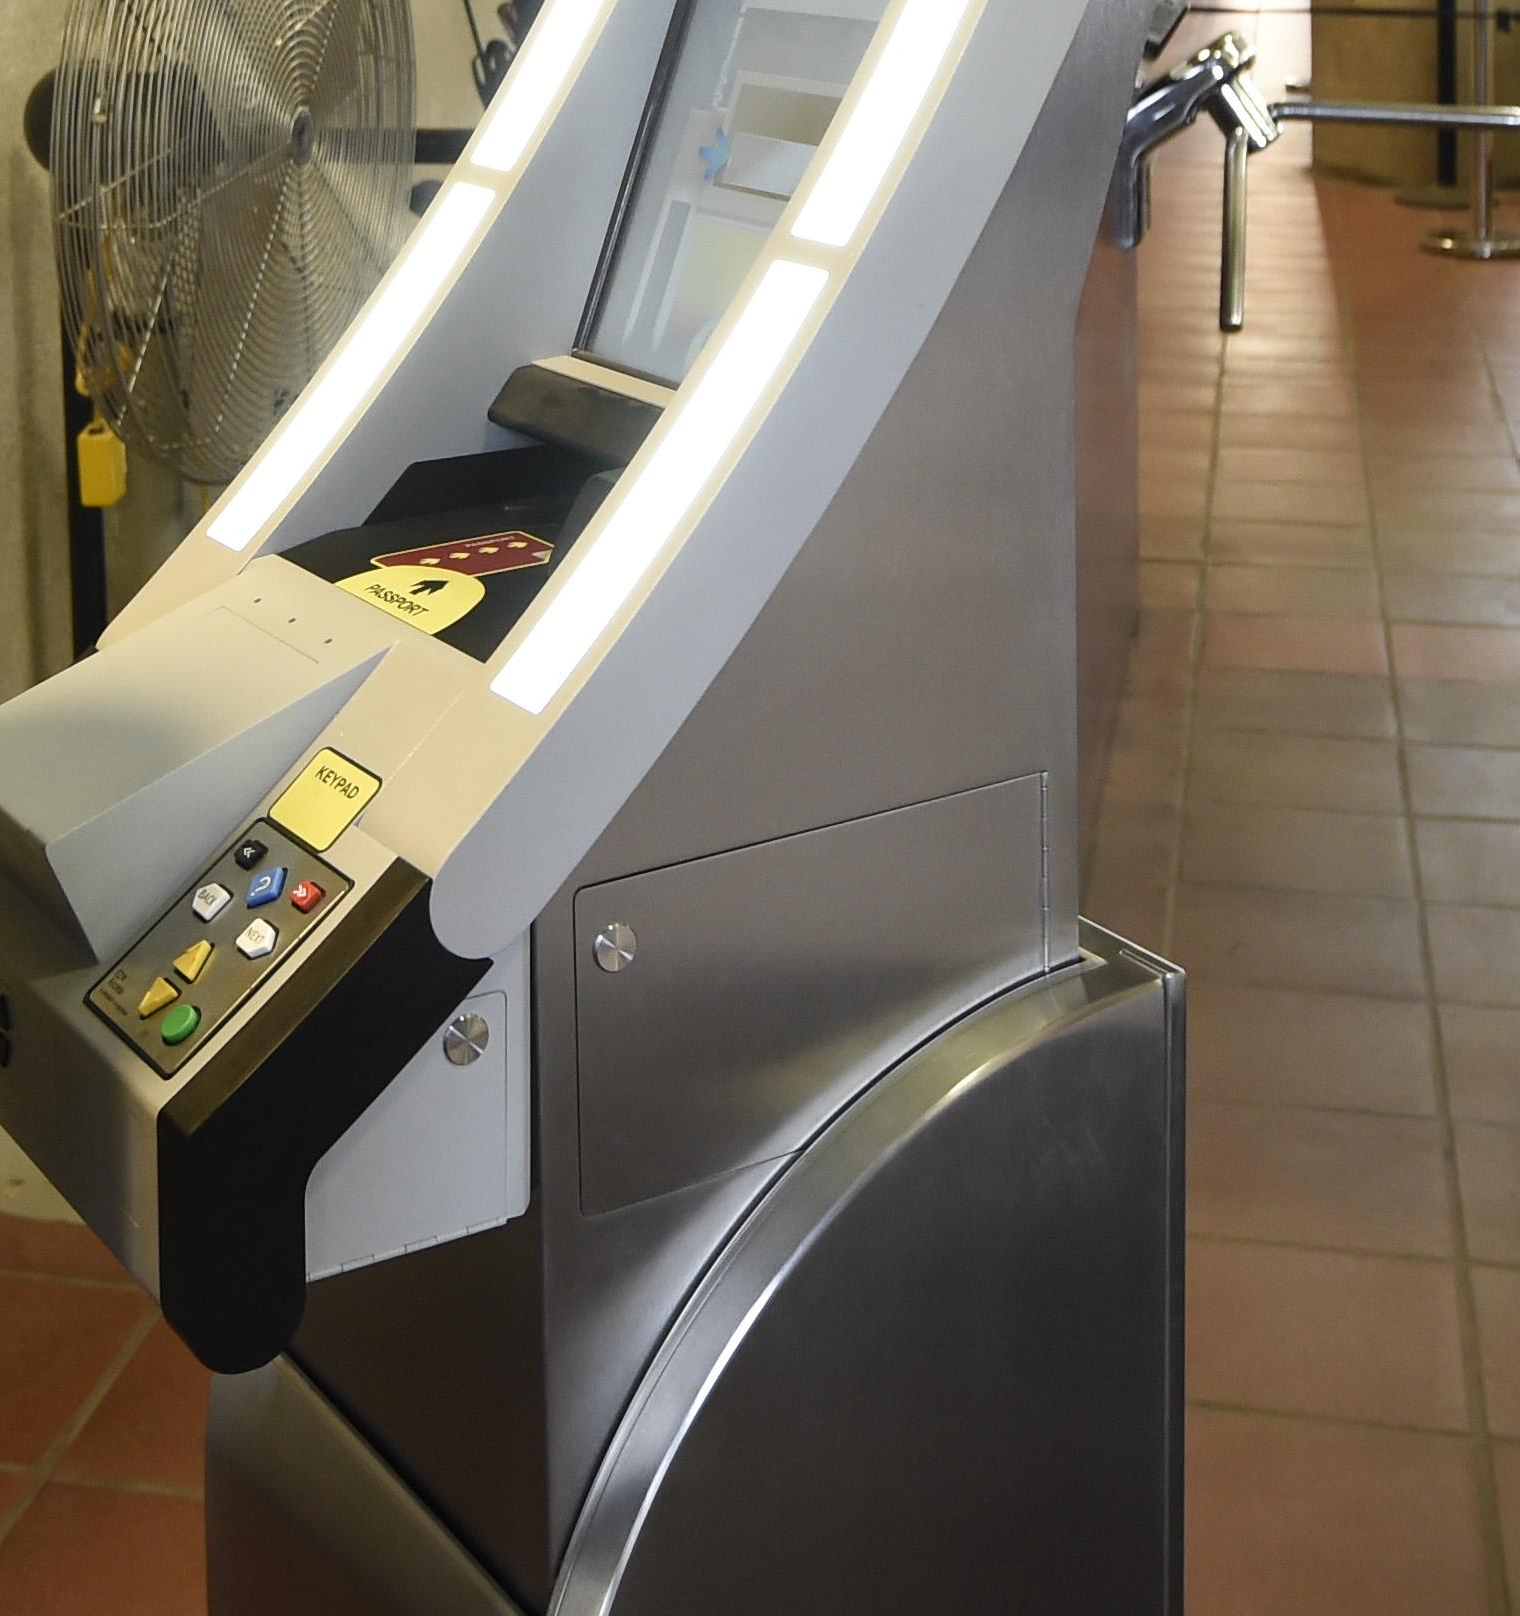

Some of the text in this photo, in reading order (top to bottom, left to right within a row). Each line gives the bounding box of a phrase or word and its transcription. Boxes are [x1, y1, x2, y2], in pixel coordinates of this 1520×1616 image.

[364, 583, 430, 617] PASSPORT
[315, 764, 360, 800] KEYPAD
[198, 888, 217, 907] BACK
[246, 926, 266, 945] NEXT
